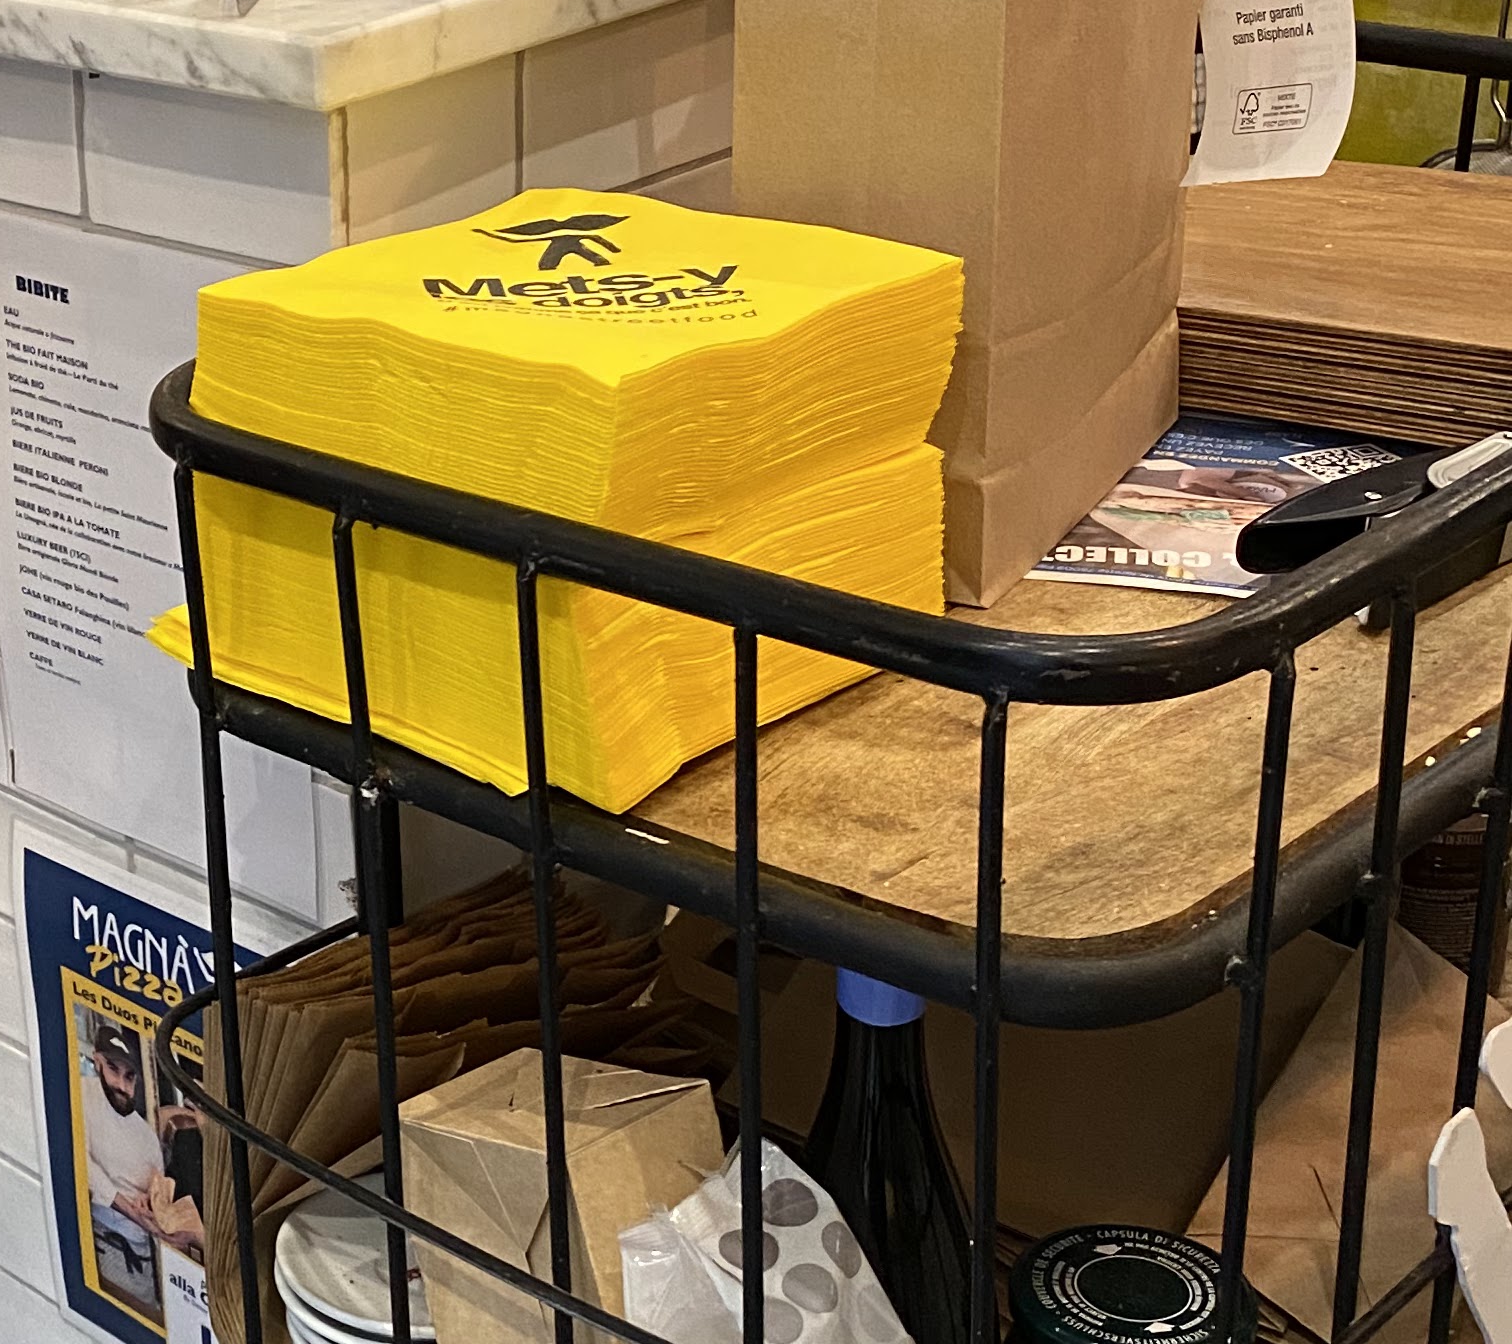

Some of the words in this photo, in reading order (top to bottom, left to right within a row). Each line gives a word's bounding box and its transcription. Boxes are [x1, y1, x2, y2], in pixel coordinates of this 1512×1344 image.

[1236, 9, 1267, 26] Papier
[1269, 2, 1304, 23] garanti
[1232, 32, 1255, 45] sans
[1257, 22, 1304, 43] Bisphenol
[1306, 21, 1314, 36] A
[15, 275, 70, 305] BIBITE
[422, 265, 739, 298] Mets-y
[532, 284, 746, 309] doigts,
[3, 306, 19, 317] EAU
[22, 344, 36, 355] BIO
[37, 348, 54, 360] FAIT
[56, 354, 88, 371] MAISON
[8, 372, 29, 386] SODA
[10, 407, 23, 417] JUS
[25, 410, 35, 420] DE
[36, 413, 64, 429] FRUITS
[1175, 447, 1224, 456] PAYEZ
[1185, 441, 1253, 451] RECEVEZ
[34, 447, 76, 467] ITALIENNE
[78, 460, 109, 477] PERONI
[1178, 453, 1280, 467] COMMANDEZ
[36, 470, 49, 482] BIO
[51, 474, 83, 493] BLONDE
[37, 505, 51, 516] BIO
[74, 517, 85, 528] LA
[86, 521, 121, 539] TOMATE
[16, 530, 48, 548] LUXURY
[49, 541, 68, 555] BEER
[21, 586, 42, 600] CASA
[43, 594, 73, 611] SETARO
[24, 608, 47, 623] VERRE
[48, 617, 58, 628] DE
[60, 621, 74, 633] VIN
[75, 627, 102, 644] ROUGE
[26, 630, 49, 646] VERRE
[50, 639, 61, 650] DE
[62, 643, 76, 655] VIN
[78, 649, 104, 666] BLANC
[72, 895, 196, 995] MAGNÀ
[85, 944, 184, 1008] Pizza
[72, 981, 97, 1005] Les
[101, 996, 139, 1026] Duos
[1096, 1229, 1149, 1241] CAPSULA
[1154, 1235, 1169, 1245] DI
[1171, 1241, 1222, 1274] SICUREZZA
[169, 1273, 196, 1299] alla
